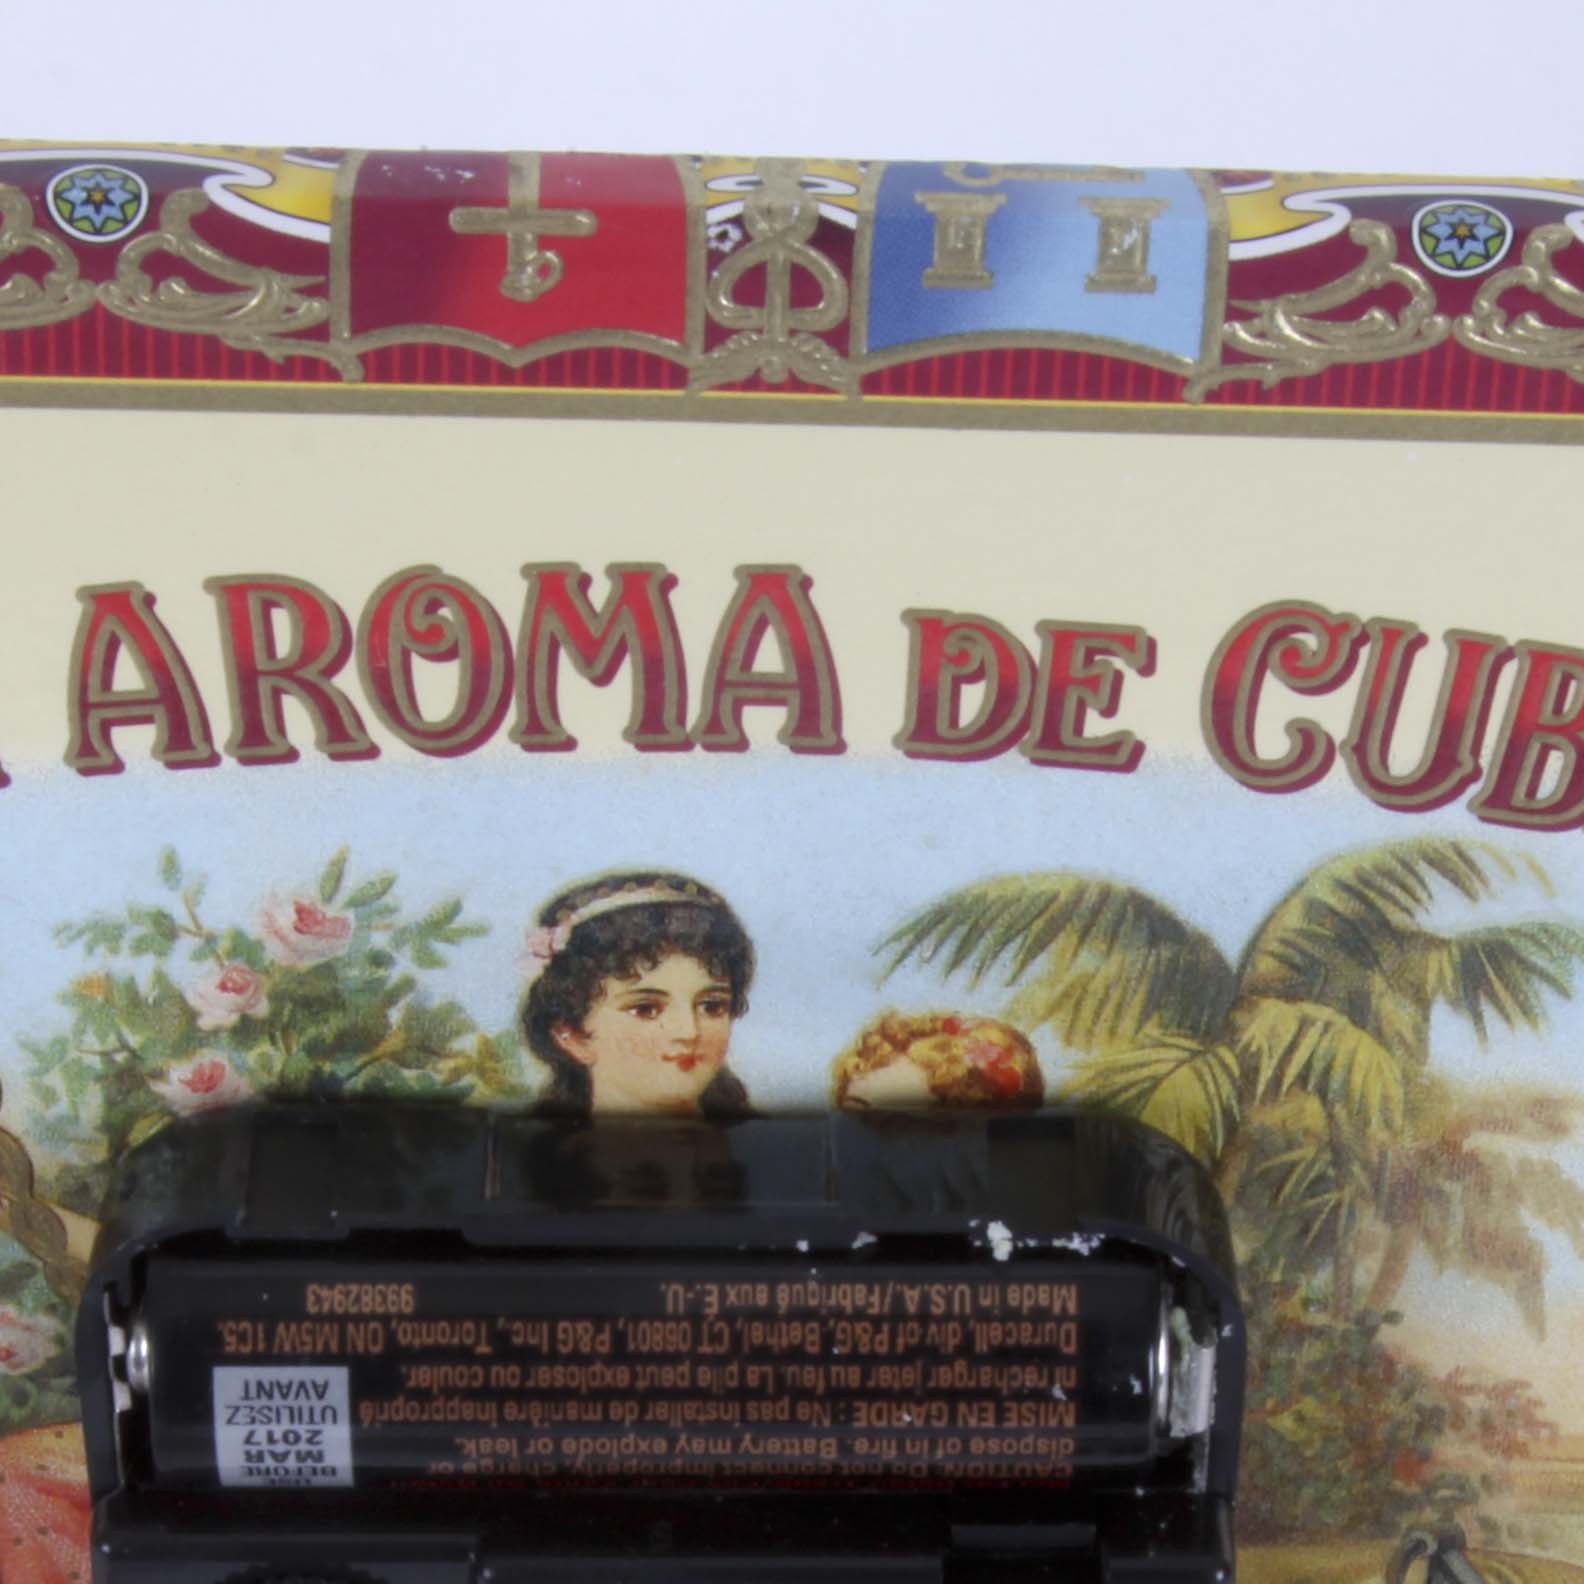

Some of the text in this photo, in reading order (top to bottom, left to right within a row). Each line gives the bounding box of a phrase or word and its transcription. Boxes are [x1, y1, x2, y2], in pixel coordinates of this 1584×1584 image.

[64, 562, 846, 777] AROMA
[892, 607, 1156, 773] DE
[306, 1284, 415, 1315] 99382943
[726, 1284, 768, 1308] aux
[978, 1284, 999, 1314] in
[1007, 1284, 1077, 1316] Made
[273, 1322, 340, 1354] M5W
[347, 1322, 384, 1354] ON
[390, 1318, 492, 1354] Toronto,
[558, 1322, 611, 1354] P&G
[698, 1322, 729, 1353] CT
[736, 1318, 821, 1354] Bethel,
[829, 1319, 889, 1354] P&G,
[968, 1319, 1076, 1354] Duracell,
[490, 1366, 521, 1388] ou
[526, 1361, 631, 1393] exploser
[636, 1360, 689, 1391] peut
[698, 1360, 738, 1394] pile
[746, 1366, 773, 1392] La
[831, 1366, 861, 1387] au
[866, 1360, 923, 1394] jeter
[240, 1380, 329, 1401] AVANT
[225, 1405, 338, 1425] UTILISEZ
[610, 1401, 638, 1428] de
[645, 1401, 741, 1428] installer
[746, 1395, 789, 1421] pas
[797, 1402, 832, 1428] Ne
[957, 1402, 995, 1428] EN
[1003, 1402, 1076, 1428] MISE
[243, 1430, 323, 1446] 2017
[454, 1437, 517, 1459] leak.
[525, 1437, 553, 1455] or
[562, 1432, 667, 1459] explode
[676, 1432, 731, 1455] may
[739, 1432, 838, 1459] Battery
[906, 1437, 928, 1460] in
[935, 1437, 961, 1460] of
[970, 1434, 1074, 1460] dispose
[244, 1450, 324, 1463] MAR
[241, 1466, 336, 1477] BEFORE
